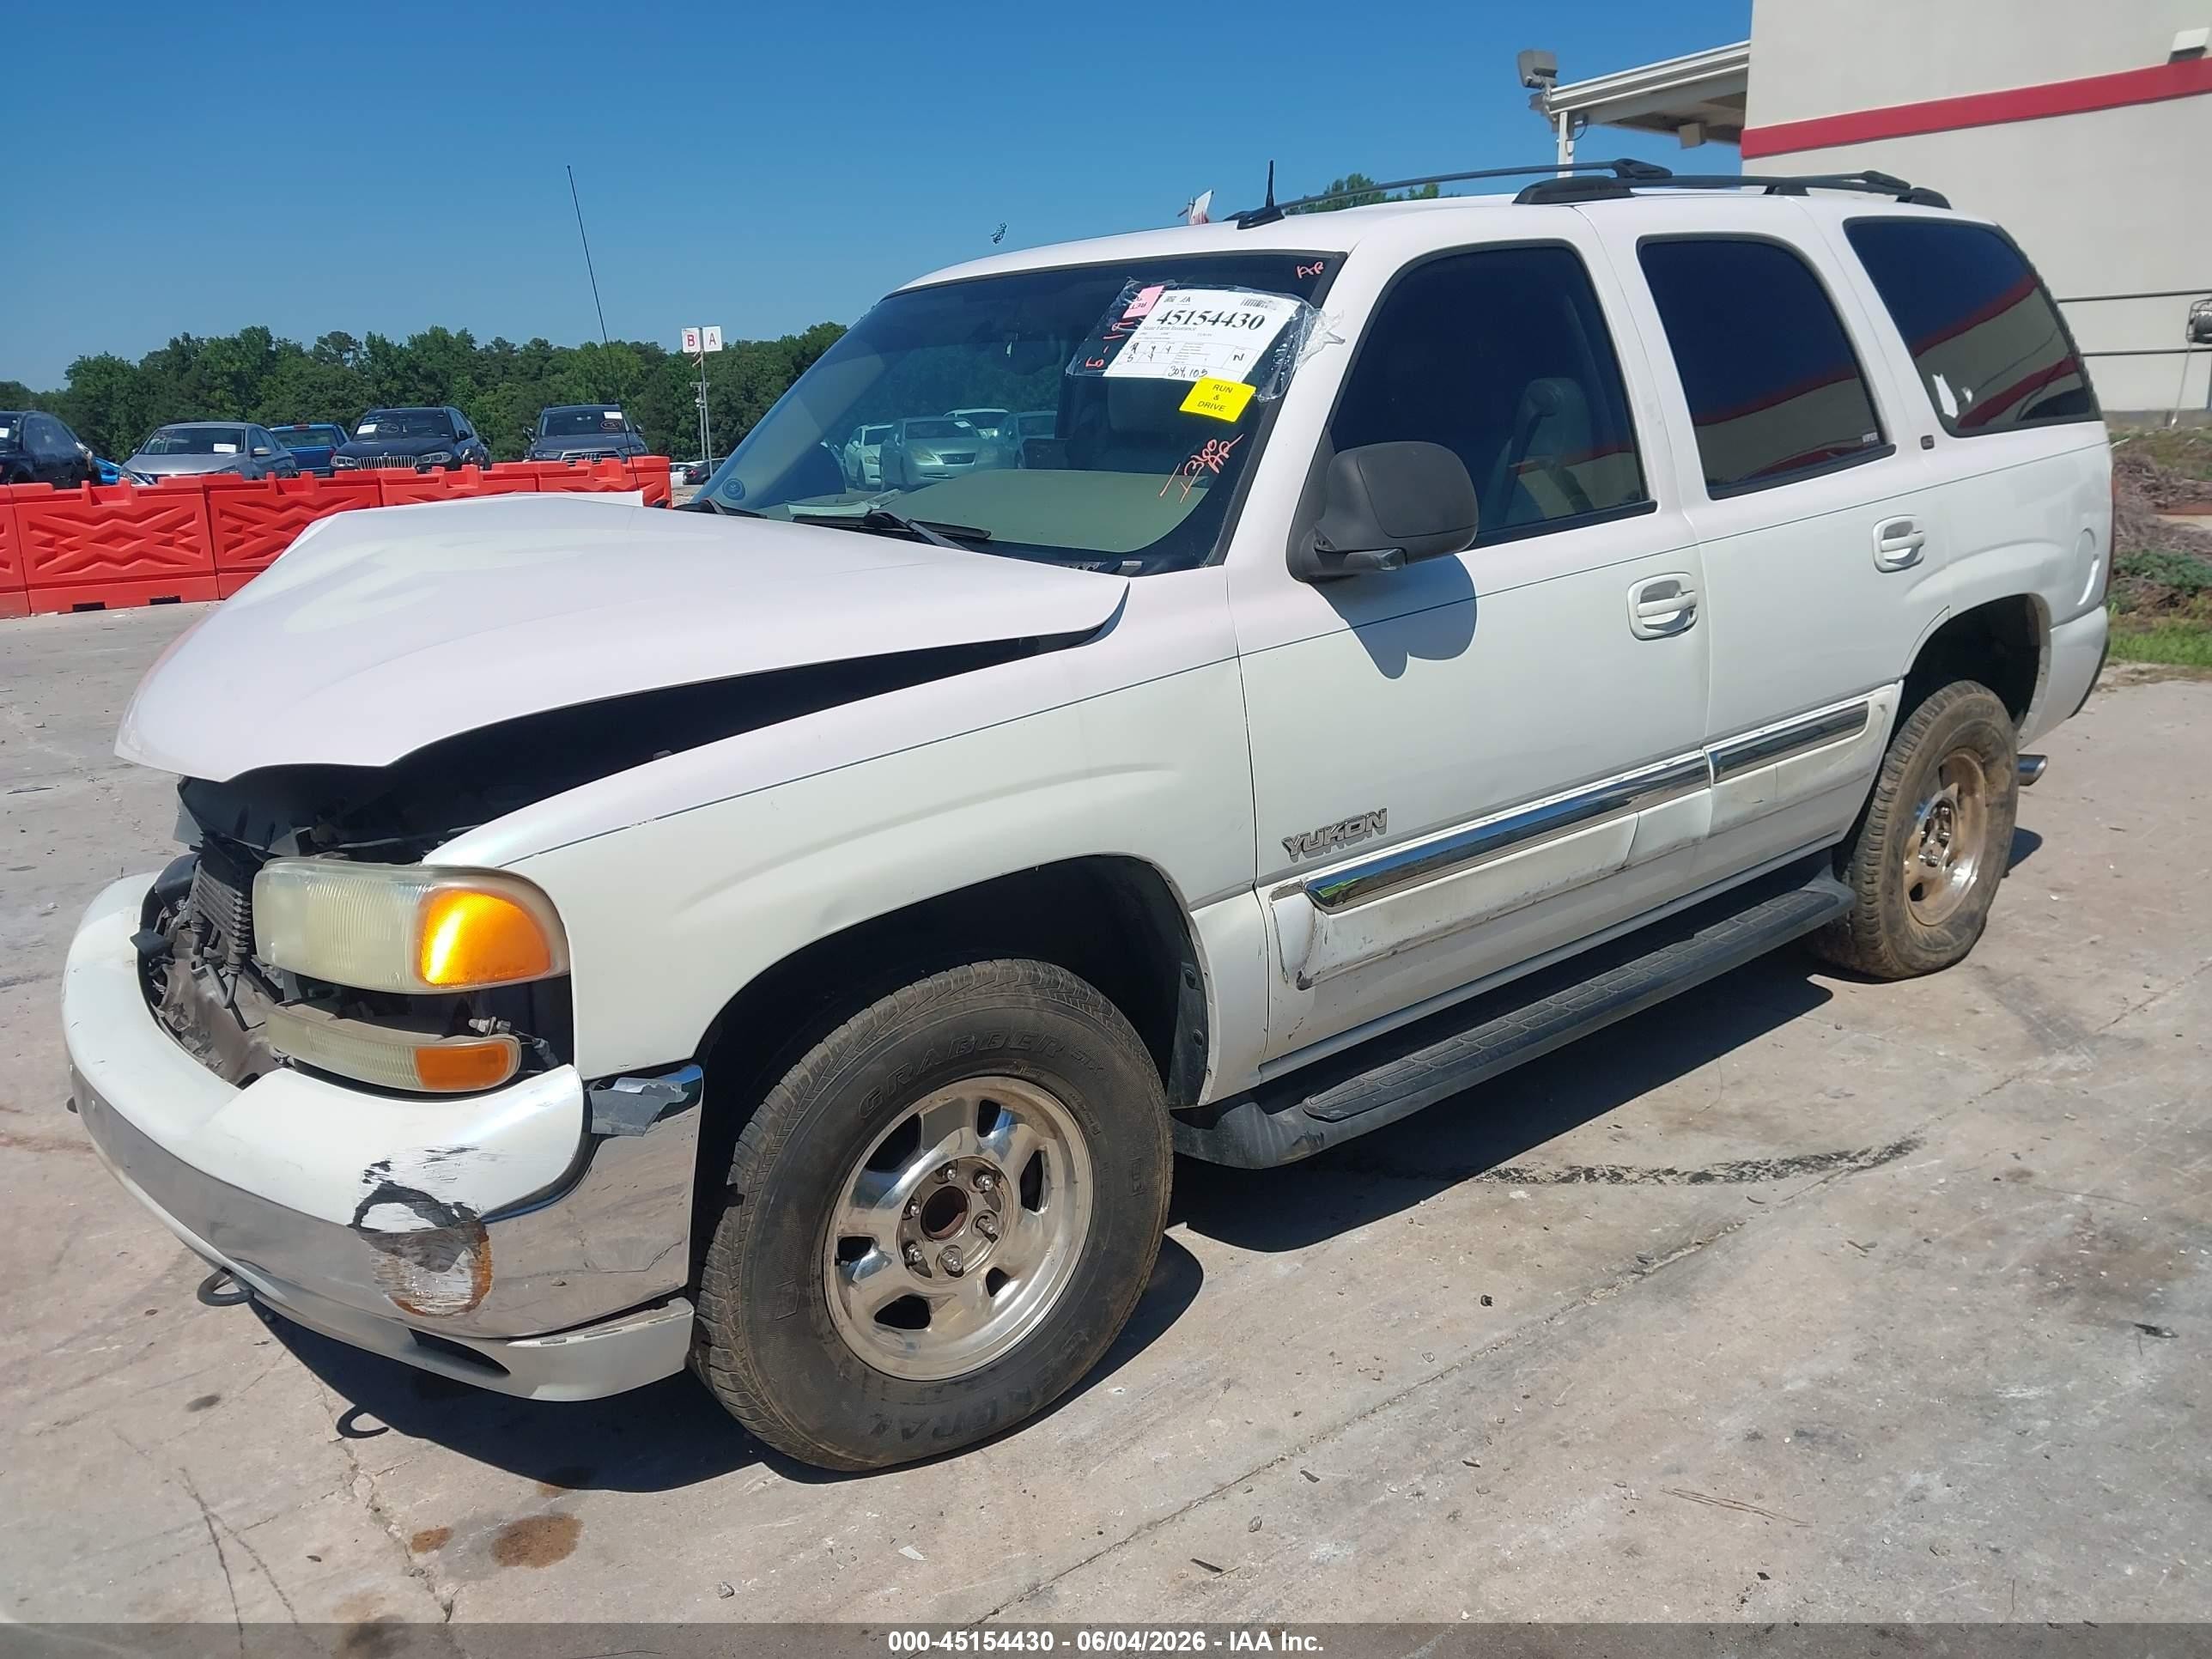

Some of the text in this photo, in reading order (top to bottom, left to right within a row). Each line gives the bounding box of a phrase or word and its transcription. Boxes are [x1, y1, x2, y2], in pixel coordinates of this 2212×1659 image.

[1157, 309, 1266, 331] 45154430
[687, 334, 696, 347] B
[708, 332, 717, 345] A
[1212, 383, 1234, 394] RUN
[1197, 400, 1227, 412] DRIVE
[1281, 808, 1388, 857] YUKON
[858, 1030, 1066, 1119] GRABBER
